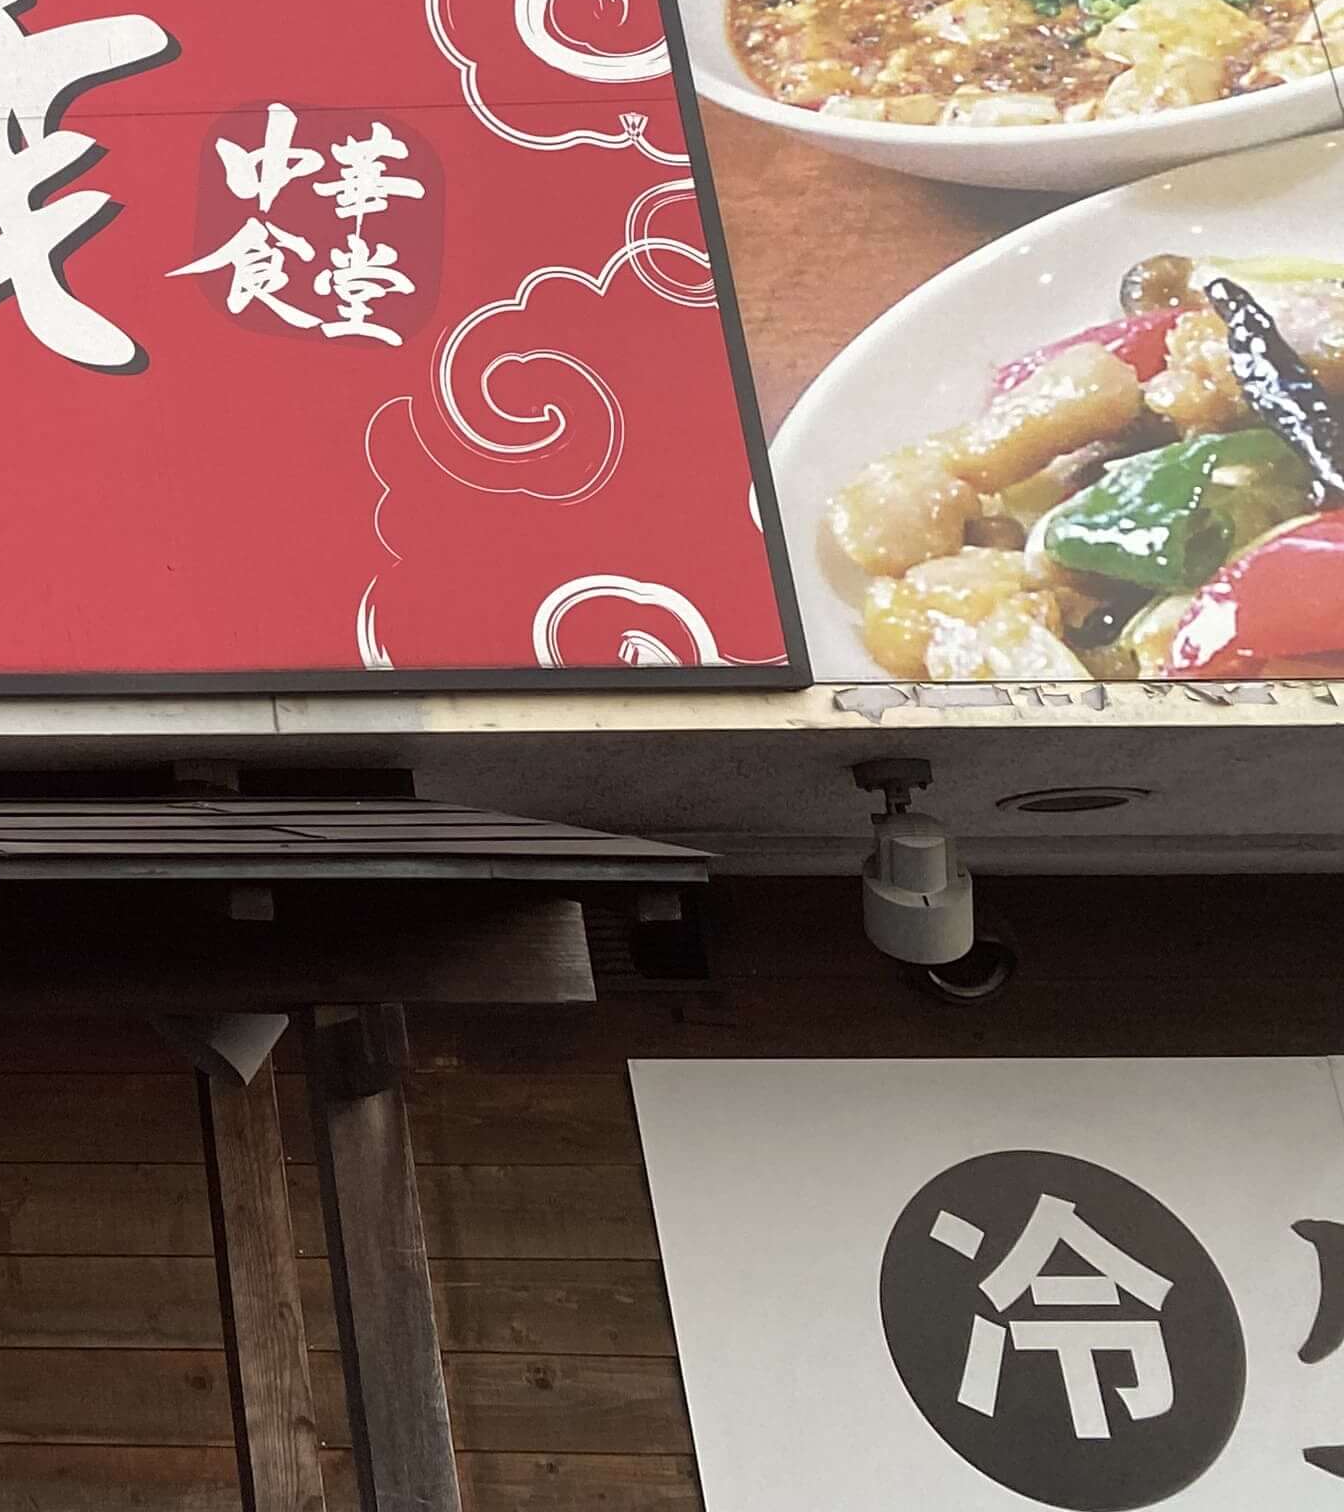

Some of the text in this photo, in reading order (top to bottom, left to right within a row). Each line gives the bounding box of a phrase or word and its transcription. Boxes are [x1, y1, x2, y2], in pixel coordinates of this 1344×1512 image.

[215, 102, 426, 230] 中華
[165, 217, 416, 346] 食堂
[929, 1192, 1174, 1440] 冷
